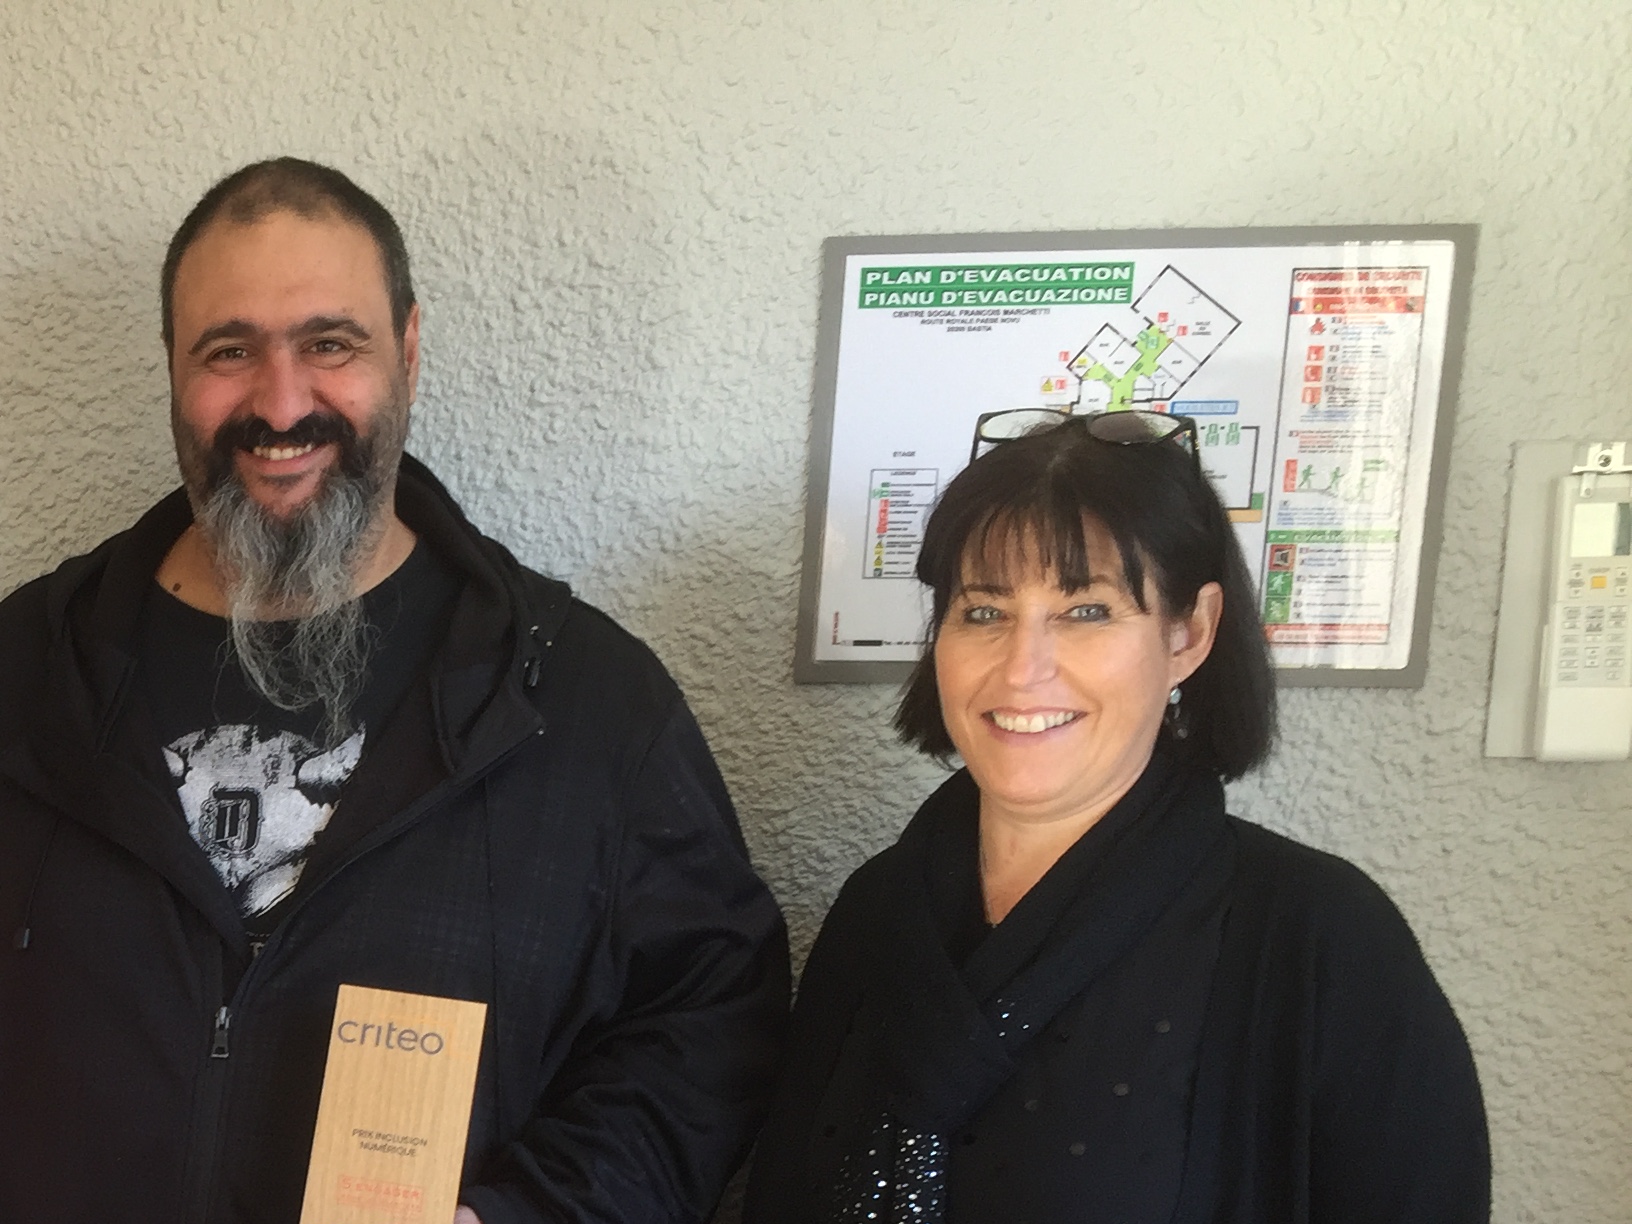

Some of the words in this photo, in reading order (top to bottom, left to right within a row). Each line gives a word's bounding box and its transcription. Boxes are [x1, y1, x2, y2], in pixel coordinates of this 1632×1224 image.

[866, 270, 931, 285] PLAN
[939, 266, 1131, 284] D'EVACUATION
[864, 291, 935, 306] PIANU
[941, 287, 1129, 305] D'EVACUAZIONE
[337, 1020, 445, 1055] criteo
[352, 1128, 373, 1140] PRIX
[375, 1132, 428, 1147] INCLUSION
